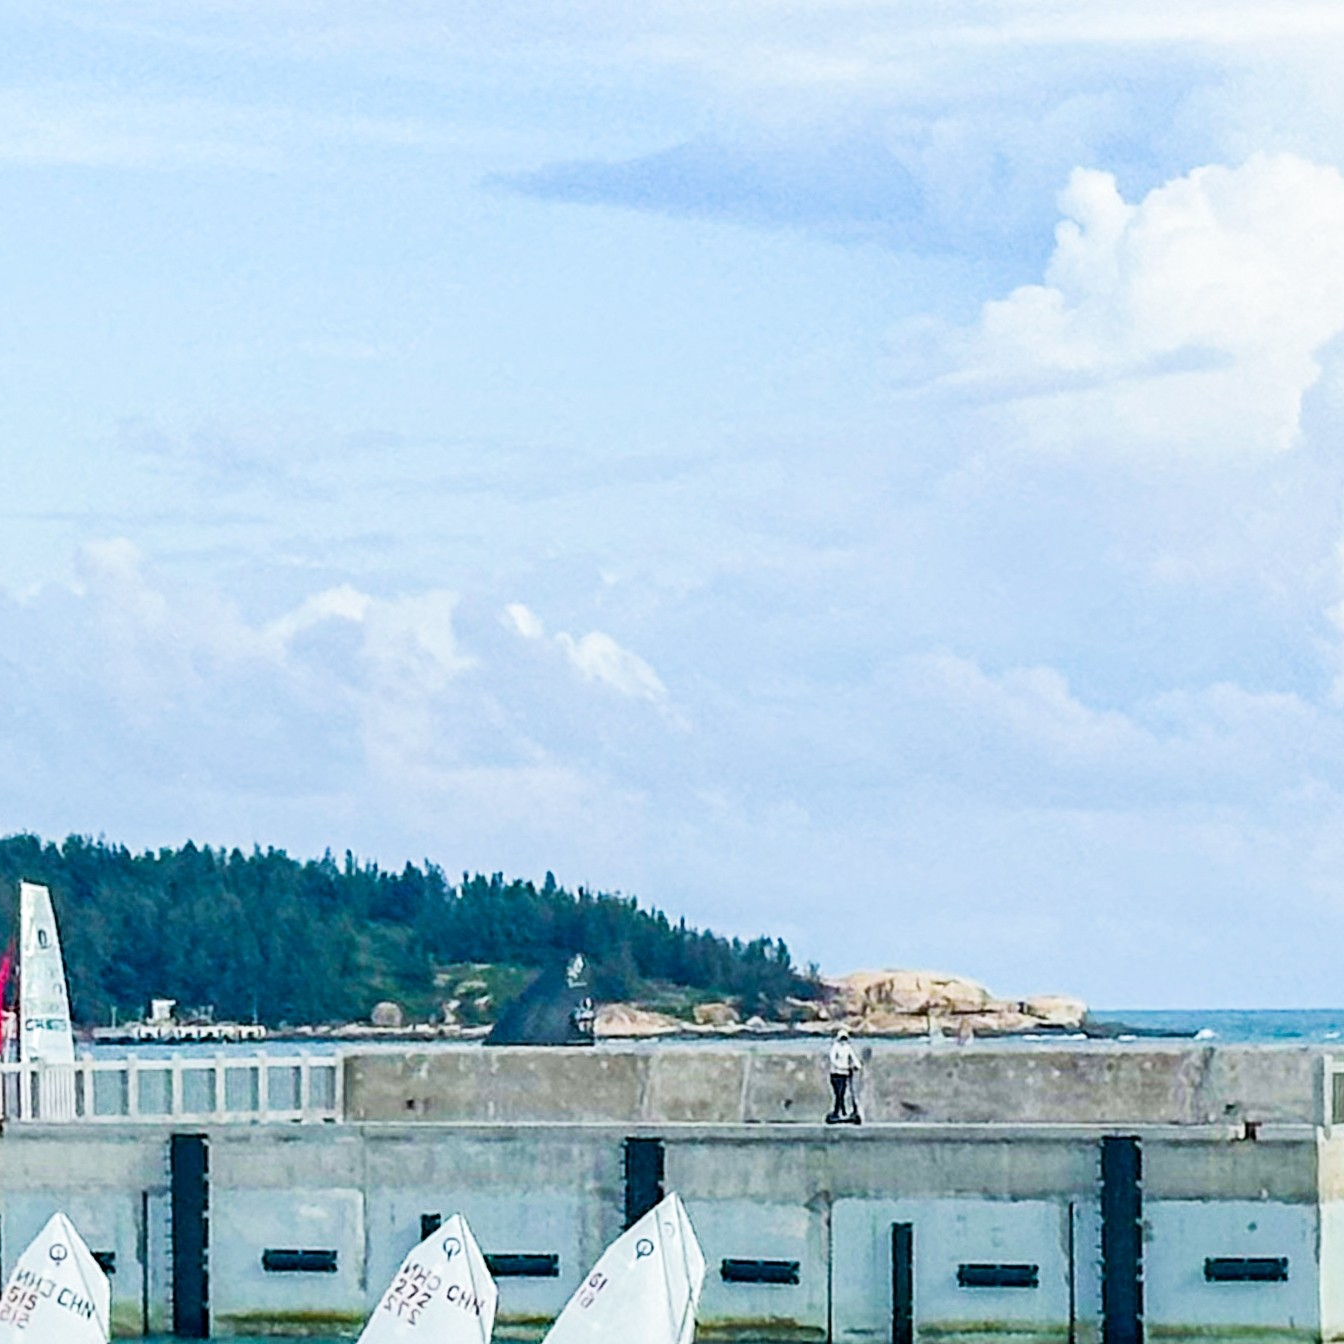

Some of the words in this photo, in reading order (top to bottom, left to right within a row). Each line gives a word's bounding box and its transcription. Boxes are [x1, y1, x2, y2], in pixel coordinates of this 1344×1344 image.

[7, 1285, 38, 1311] 515
[57, 1287, 96, 1319] CHN
[395, 1278, 432, 1309] 272
[446, 1284, 485, 1316] CHN
